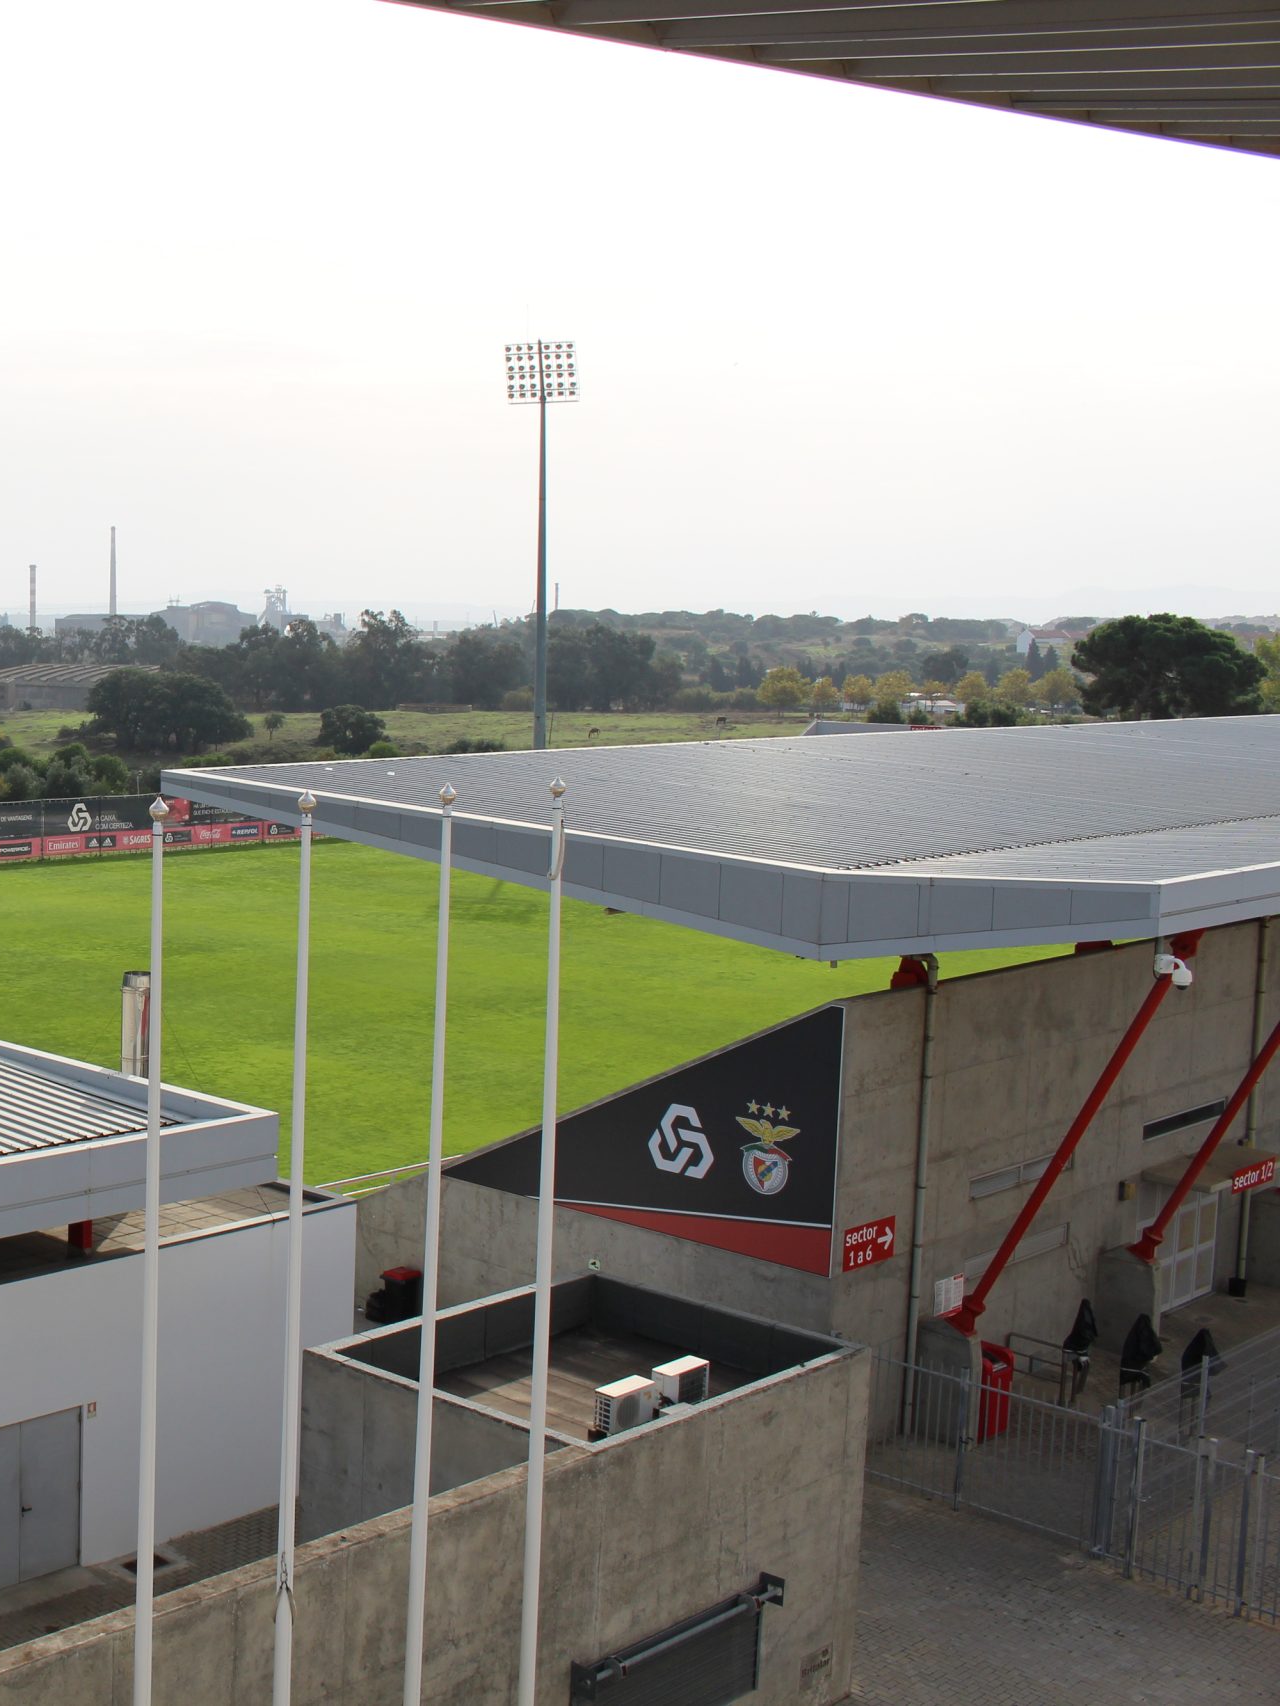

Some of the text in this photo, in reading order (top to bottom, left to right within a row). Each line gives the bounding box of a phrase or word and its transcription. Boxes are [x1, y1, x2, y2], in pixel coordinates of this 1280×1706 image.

[48, 841, 78, 851] Emirates
[129, 834, 151, 845] SAGRES
[1233, 1161, 1273, 1190] sector 1/2
[845, 1226, 878, 1247] sector
[849, 1244, 872, 1266] 1 a 6
